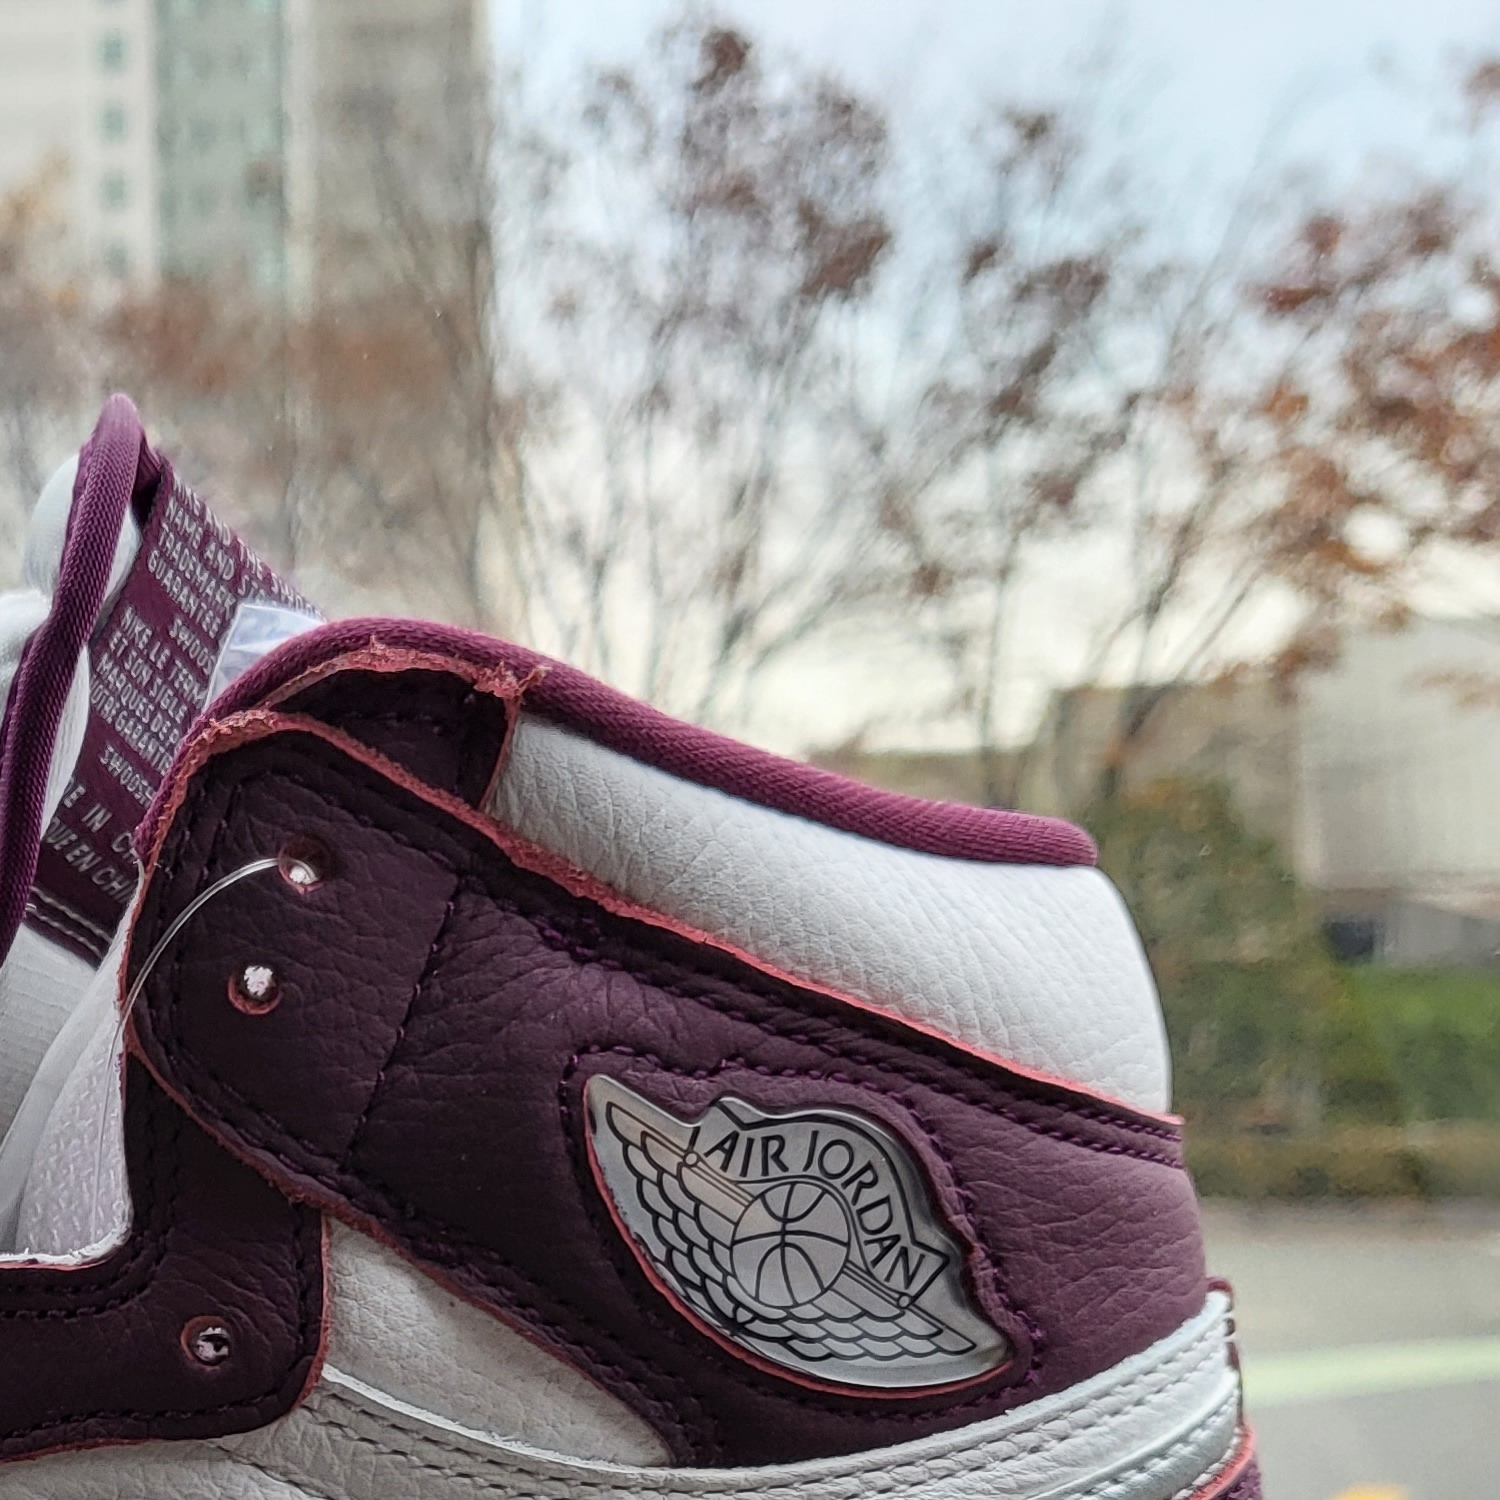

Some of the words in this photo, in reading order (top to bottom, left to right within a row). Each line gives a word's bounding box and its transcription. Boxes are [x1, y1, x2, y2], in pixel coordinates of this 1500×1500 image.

[157, 521, 237, 619] TRADEMARK
[165, 496, 204, 551] NAME
[204, 541, 236, 581] AND
[204, 504, 231, 547] AND
[237, 537, 263, 582] THE
[147, 549, 222, 640] GUARANTEE
[108, 630, 129, 659] ET
[123, 649, 153, 688] SON
[148, 676, 188, 724] SIGLE
[148, 641, 171, 670] LE
[167, 659, 209, 710] TERM
[168, 617, 217, 676] SWOOS
[96, 651, 155, 724] MARQUES
[100, 743, 155, 810] SWOOSH
[81, 802, 113, 834] IN
[65, 843, 102, 873] EN
[703, 1129, 790, 1178] AIR
[802, 1129, 927, 1290] JORDAN
